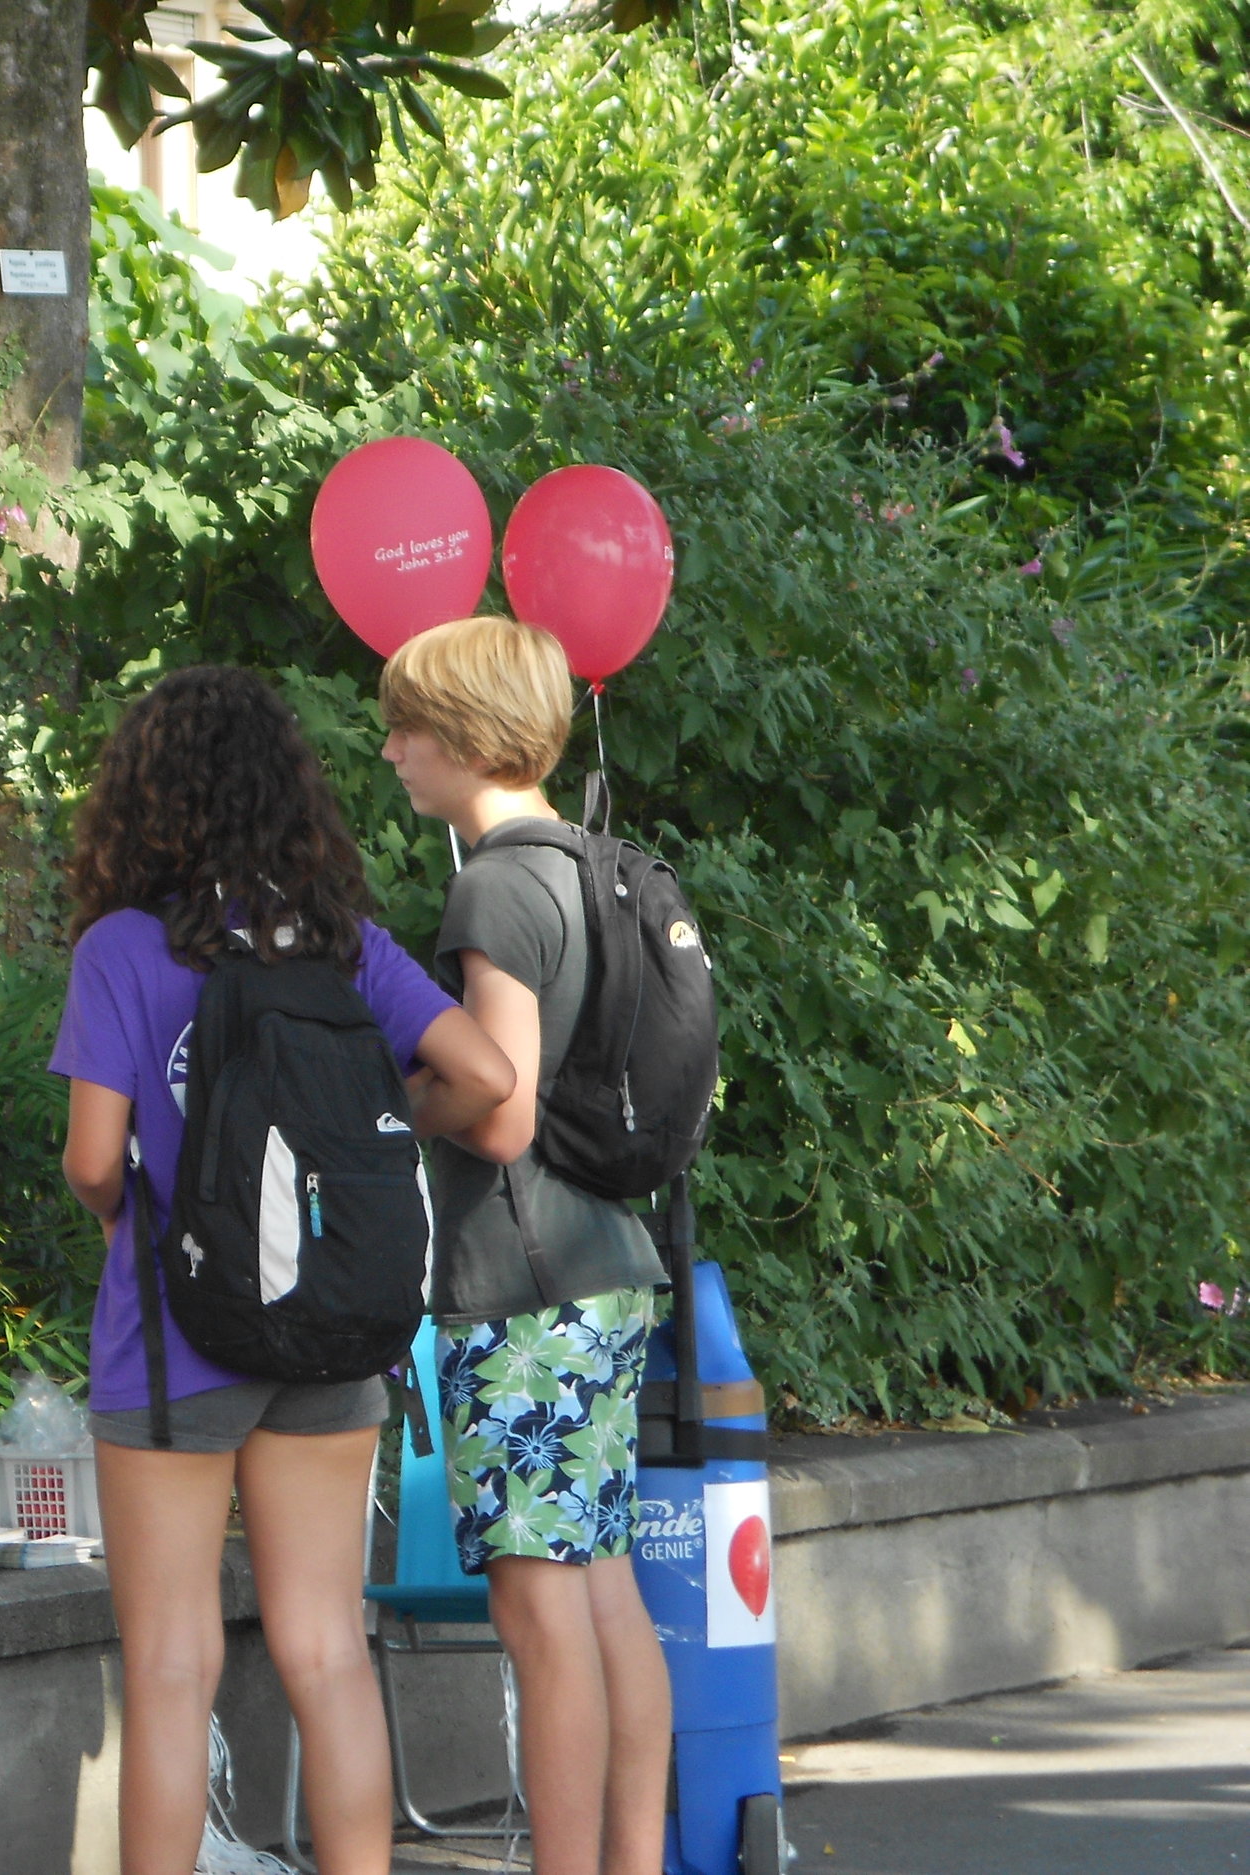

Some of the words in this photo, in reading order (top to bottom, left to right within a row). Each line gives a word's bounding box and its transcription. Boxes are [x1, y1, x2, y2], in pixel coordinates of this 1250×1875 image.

[374, 542, 405, 562] God
[410, 536, 444, 554] loves
[447, 529, 469, 547] you
[396, 556, 431, 572] John
[433, 545, 463, 563] 3:16
[636, 1511, 703, 1538] nde
[641, 1541, 695, 1561] GENIE
